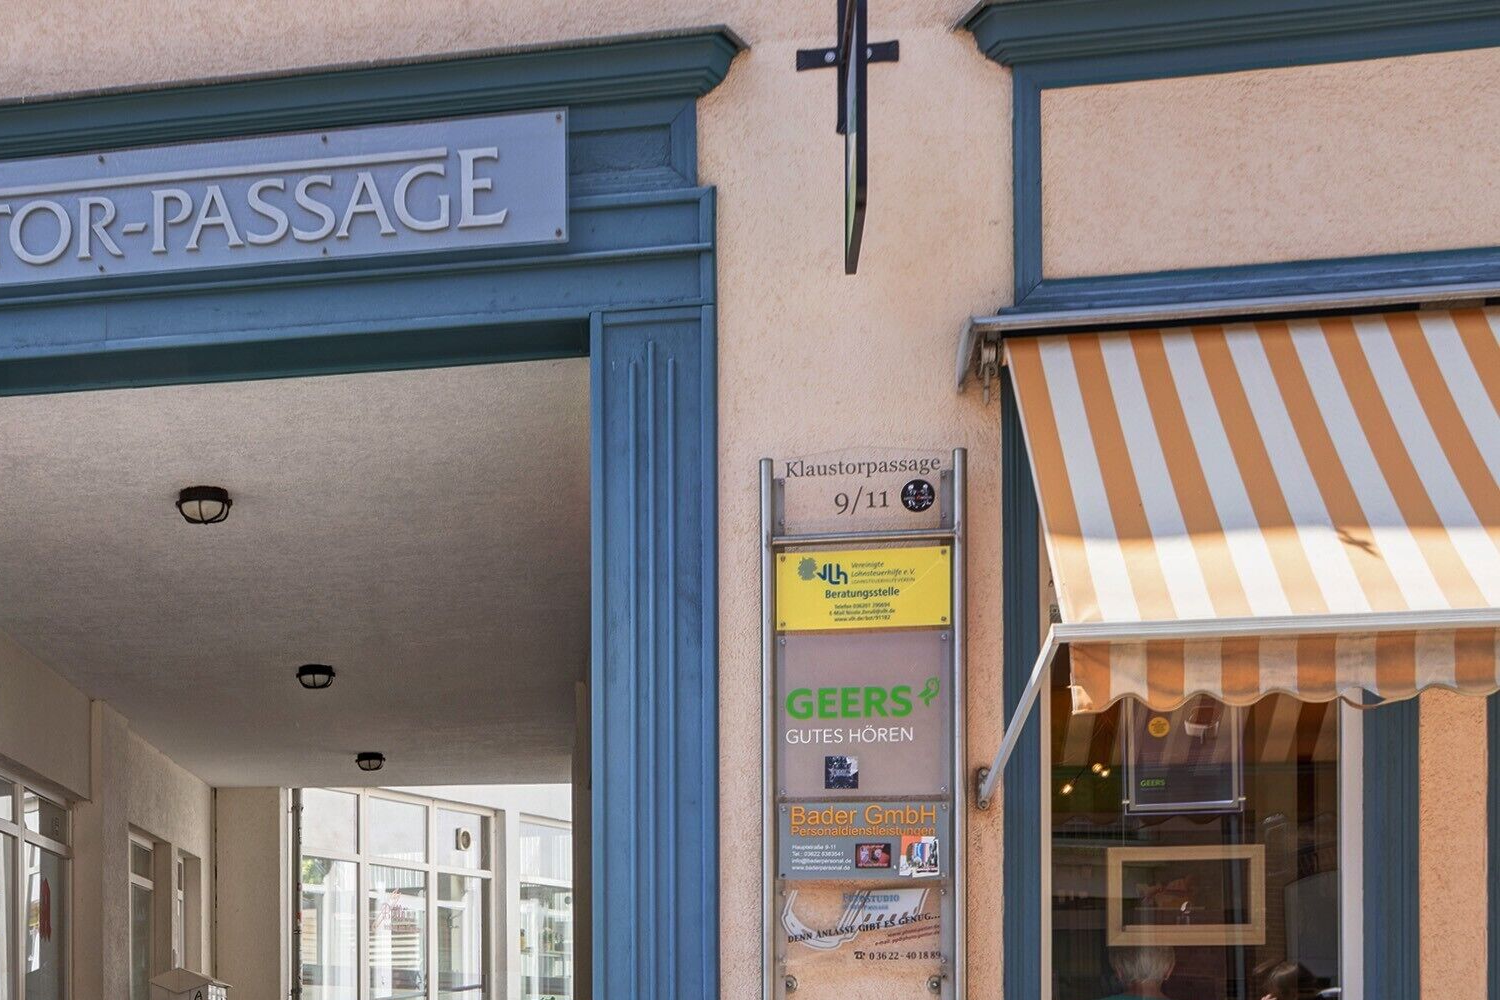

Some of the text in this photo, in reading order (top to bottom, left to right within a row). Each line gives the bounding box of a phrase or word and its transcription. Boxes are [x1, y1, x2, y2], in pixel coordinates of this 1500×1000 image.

[785, 457, 941, 478] Klaustorpassage
[834, 486, 890, 514] 9/11
[825, 586, 900, 599] Beratungsstelle
[786, 685, 913, 720] GEERS
[786, 725, 914, 744] GUTES HÖREN
[791, 805, 936, 825] Bader GmbH
[791, 825, 936, 836] Personaldienstleistungen
[788, 933, 812, 943] DENN
[858, 921, 881, 932] GIBT
[884, 918, 895, 927] ES
